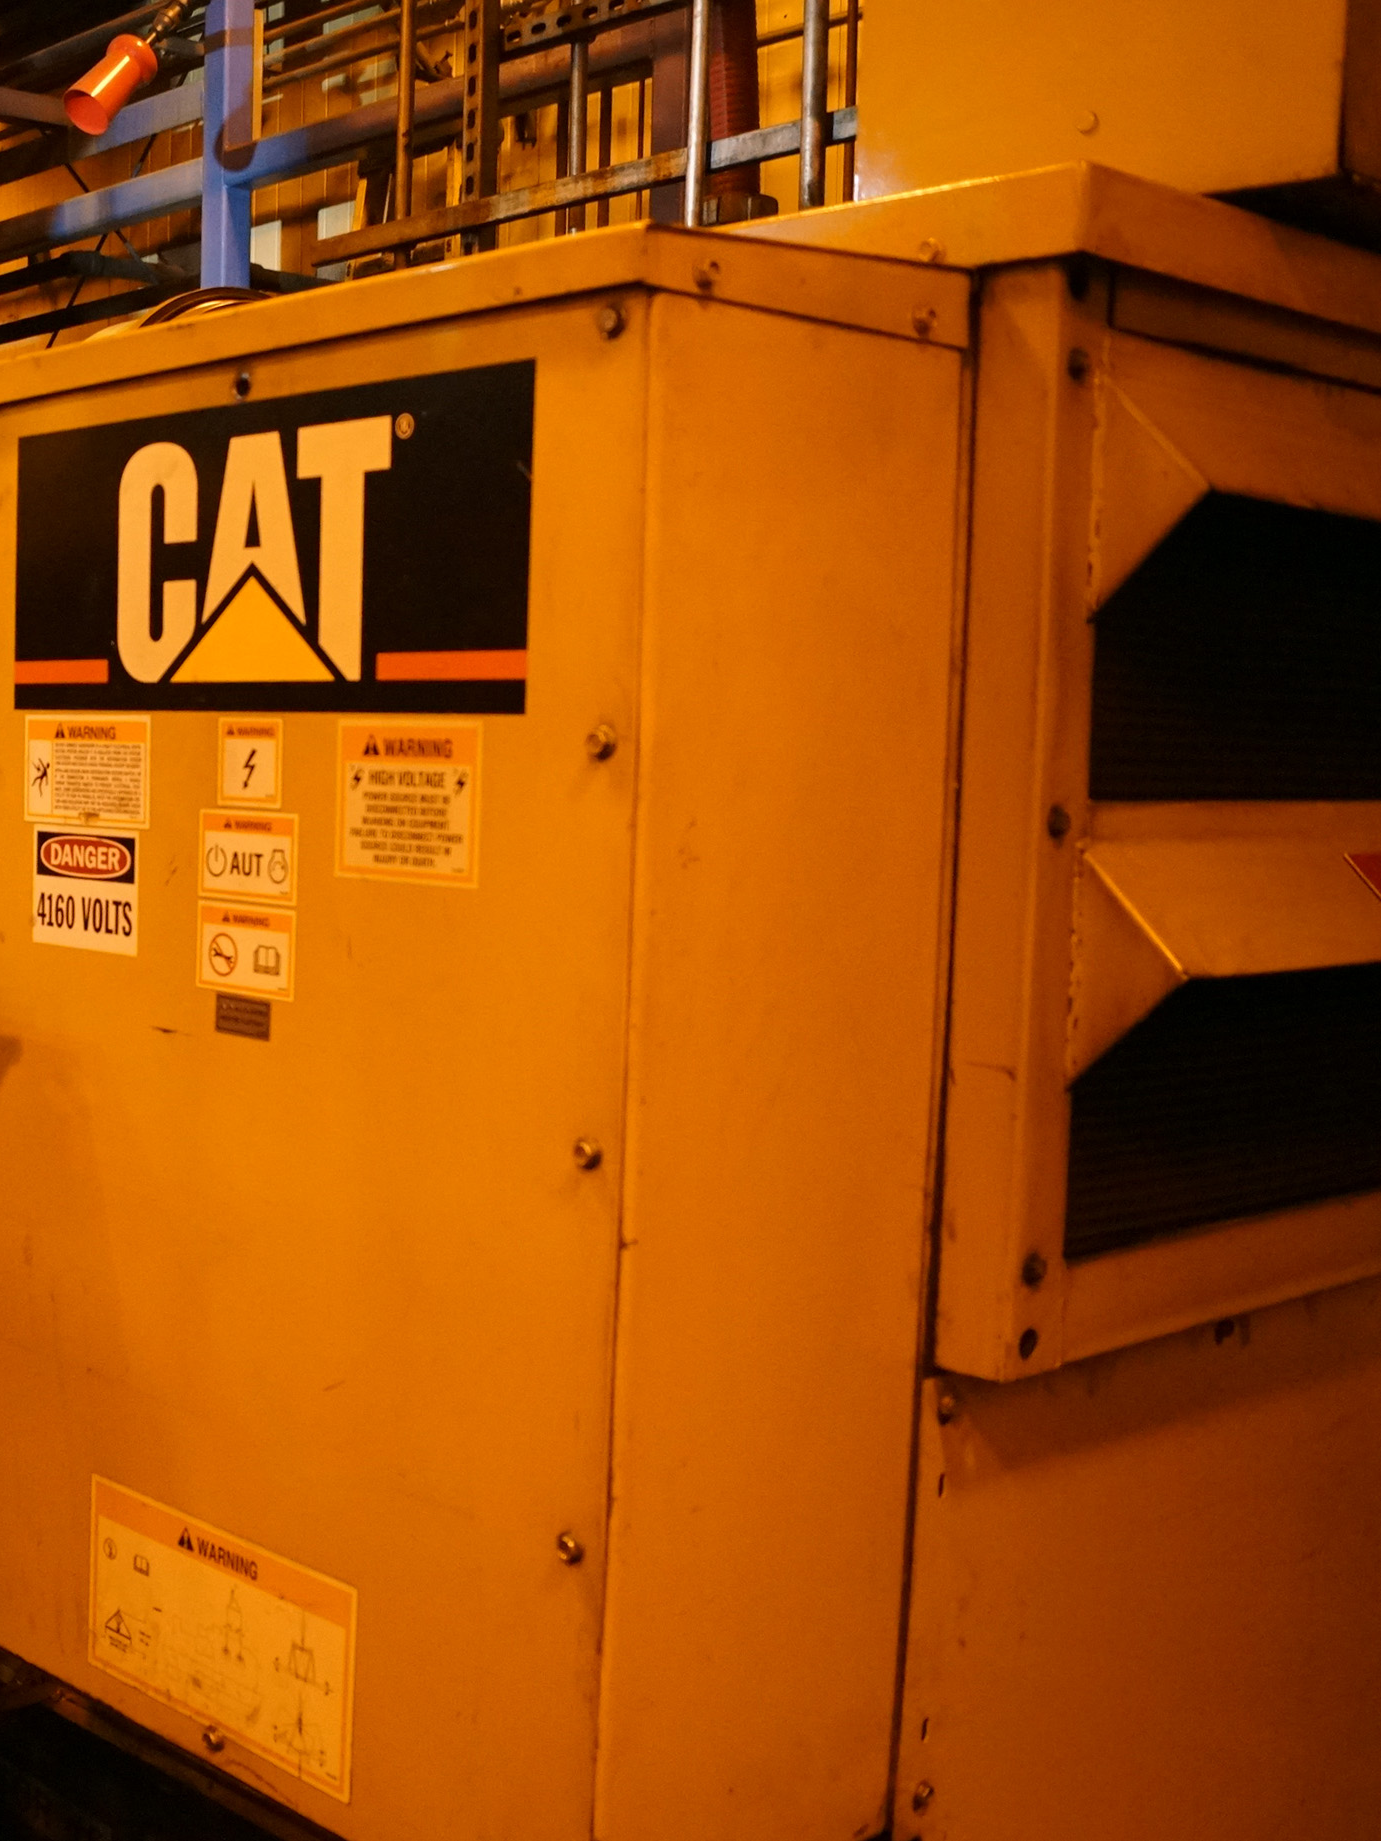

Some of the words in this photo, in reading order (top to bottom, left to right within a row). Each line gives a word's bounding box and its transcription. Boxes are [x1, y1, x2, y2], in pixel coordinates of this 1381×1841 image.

[116, 414, 392, 684] CAT
[67, 726, 116, 740] WARNING
[383, 737, 454, 759] WARNING
[368, 770, 395, 787] HIGH
[398, 771, 446, 788] VOLTAGE
[235, 820, 273, 831] WARNING
[50, 843, 120, 871] DANGER
[229, 851, 263, 877] AUT
[37, 892, 75, 930] 4160
[81, 896, 132, 938] VOLTS
[196, 1536, 259, 1581] WARNING
